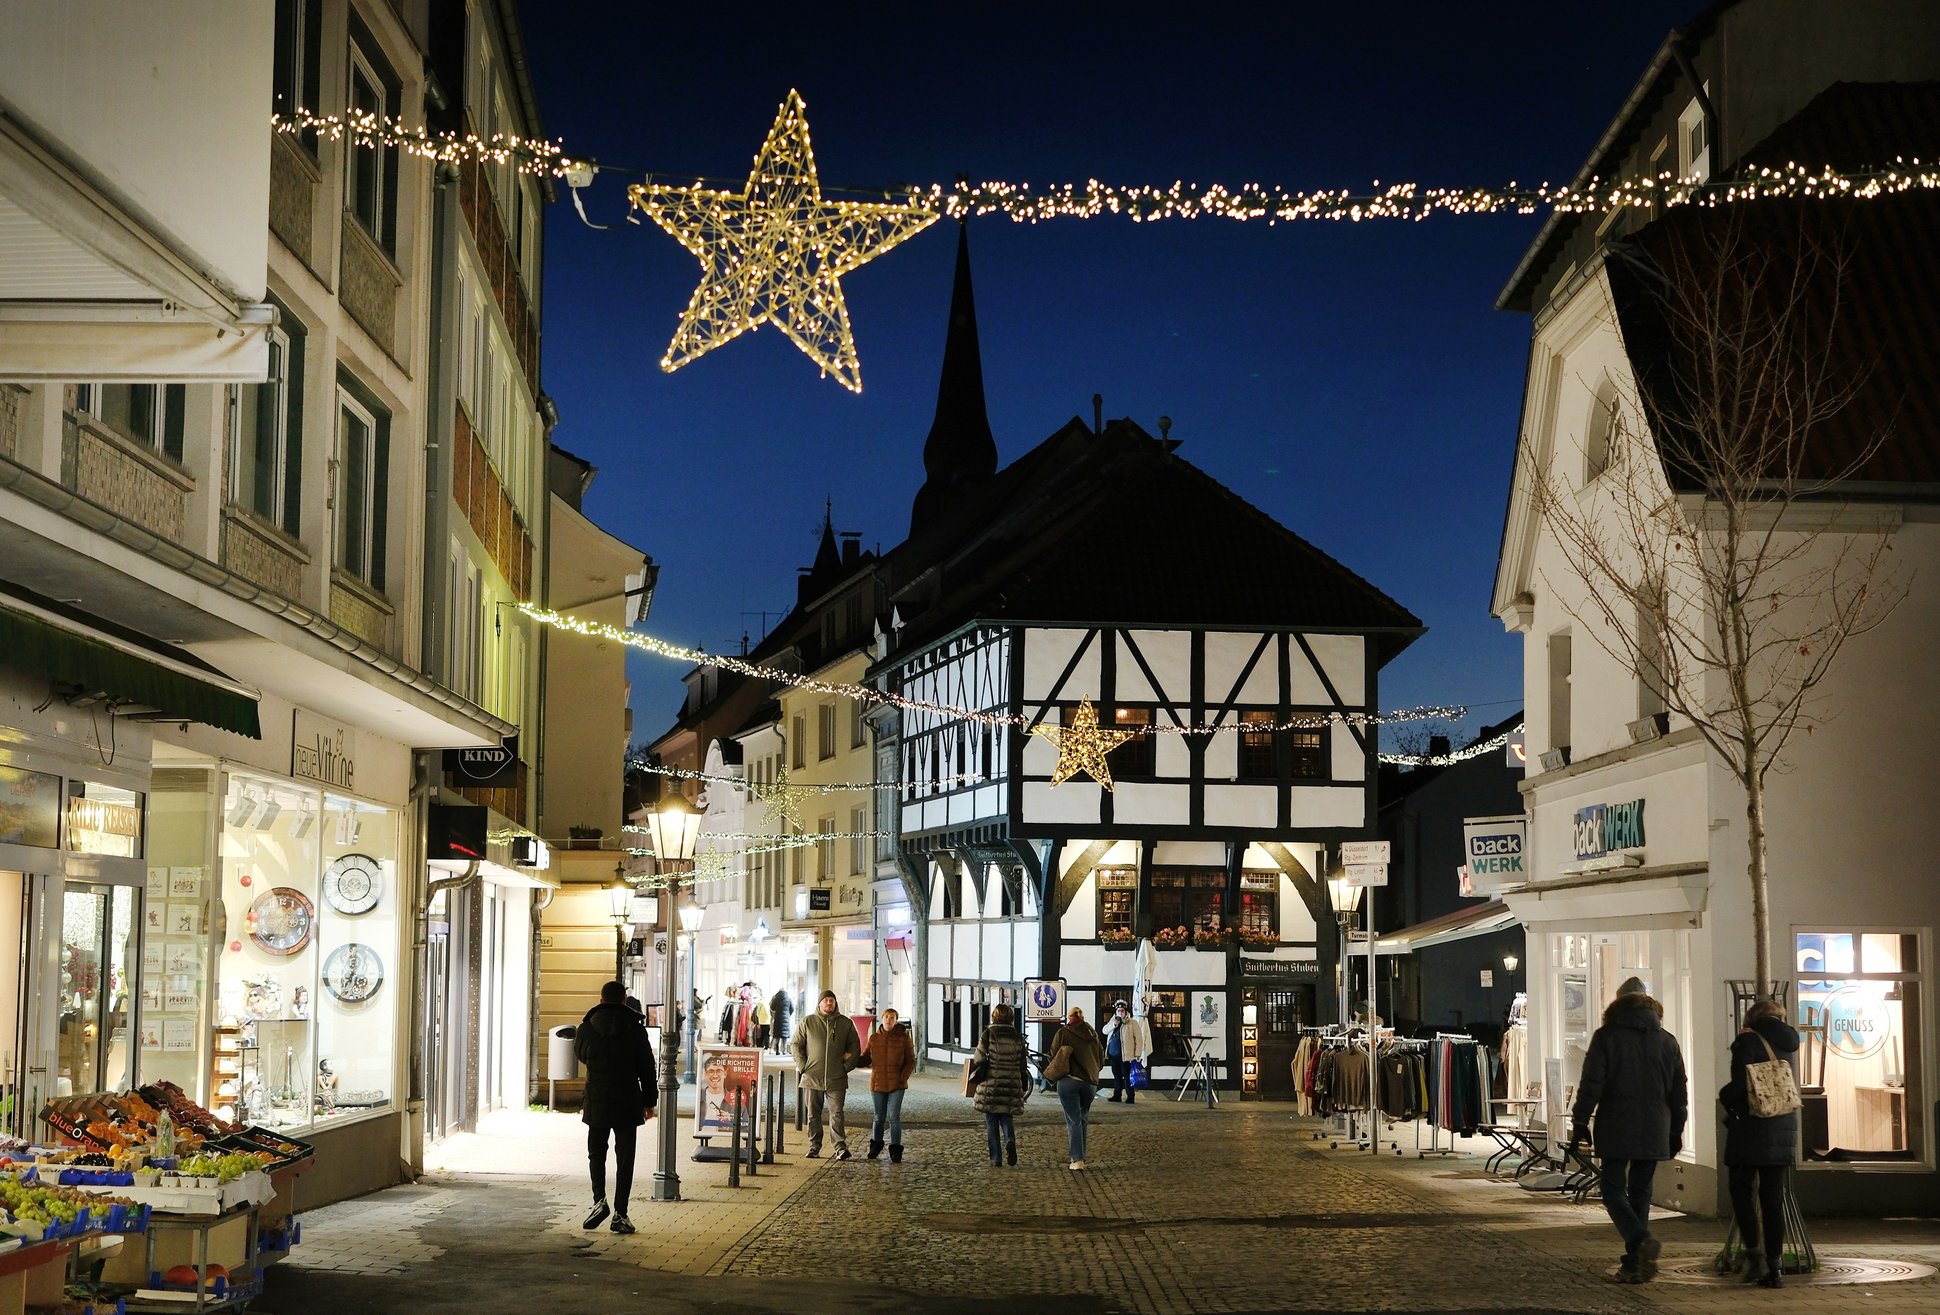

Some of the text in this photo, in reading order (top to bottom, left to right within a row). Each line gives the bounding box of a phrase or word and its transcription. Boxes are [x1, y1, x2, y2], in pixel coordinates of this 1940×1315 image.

[317, 731, 353, 787] Vitrine
[464, 750, 505, 761] KIND
[103, 802, 140, 837] REISEN
[1573, 799, 1645, 856] back WERK
[1472, 836, 1520, 854] back
[1472, 856, 1523, 874] WERK
[1245, 961, 1320, 973] Suitbertus Stuben
[1036, 1009, 1054, 1017] ZONE
[1834, 1018, 1874, 1032] GENUSS
